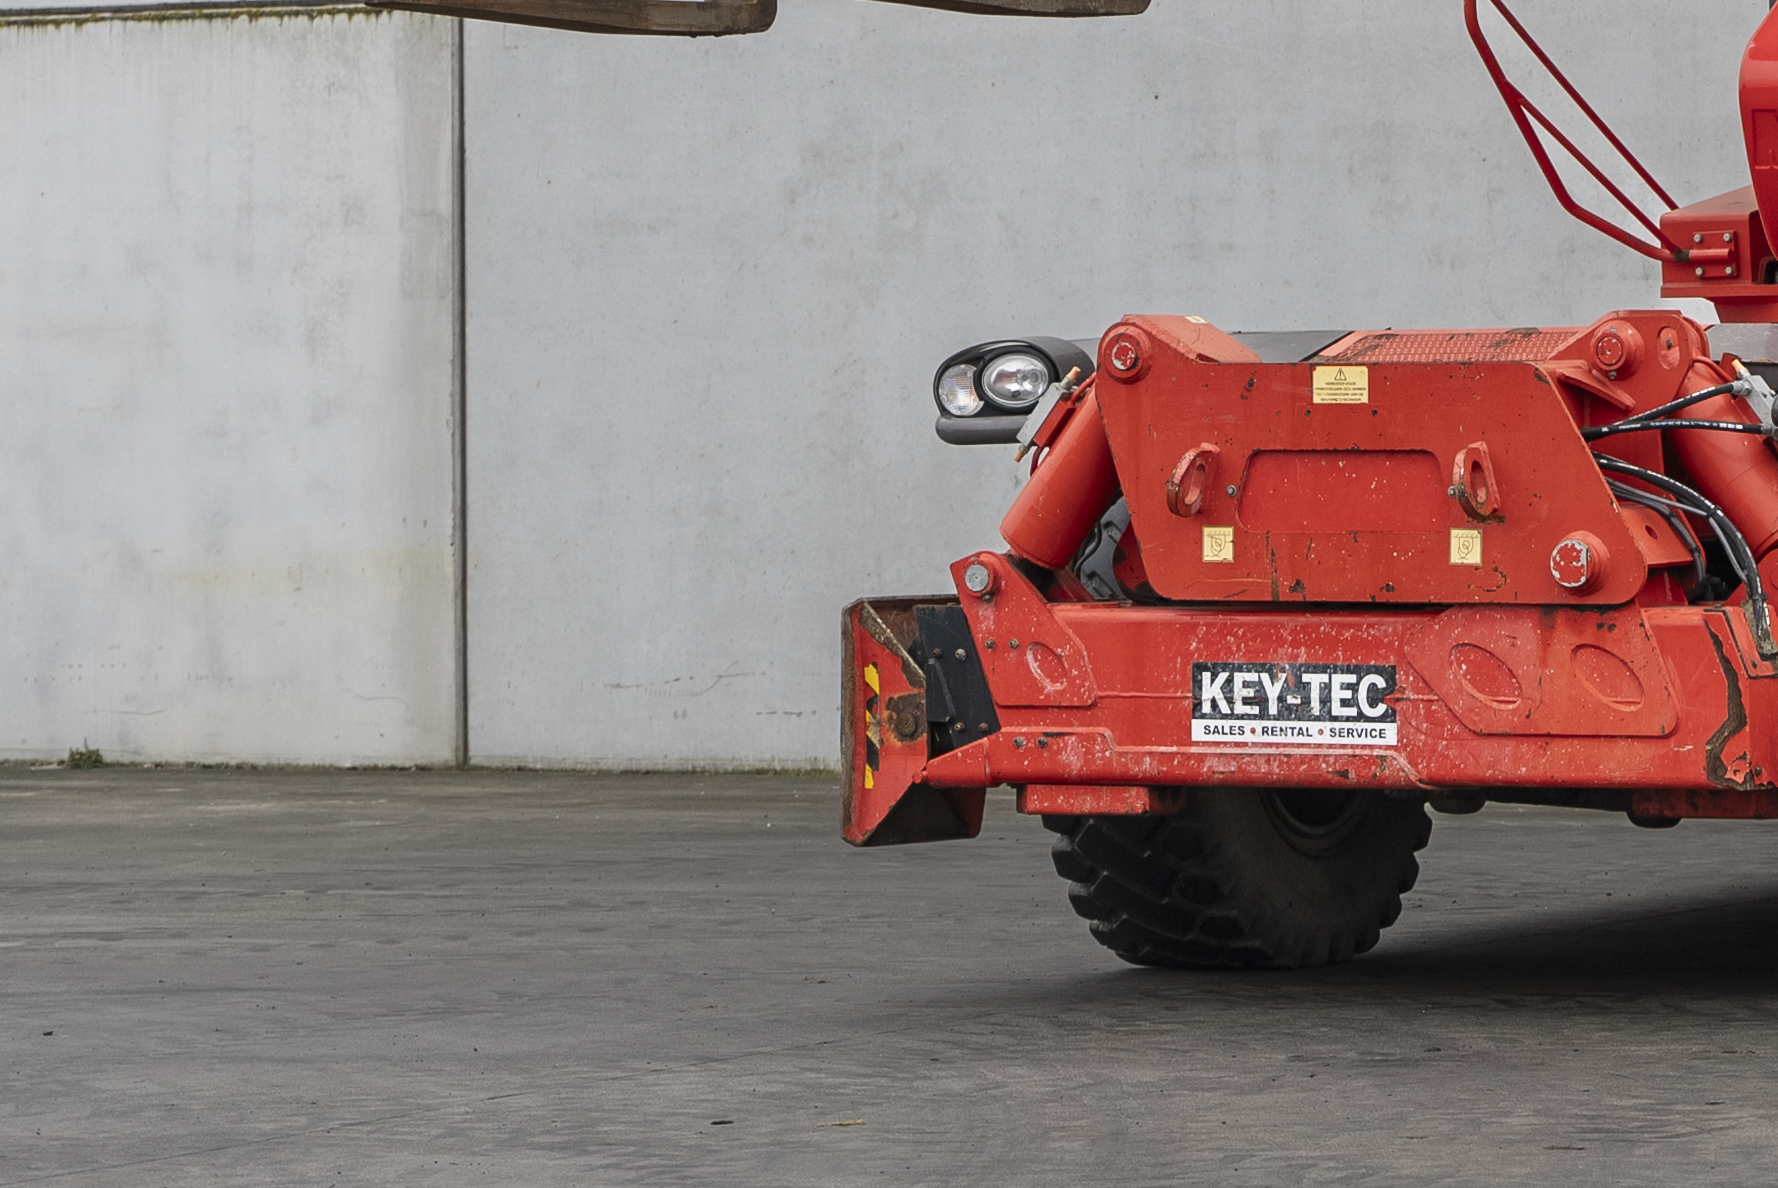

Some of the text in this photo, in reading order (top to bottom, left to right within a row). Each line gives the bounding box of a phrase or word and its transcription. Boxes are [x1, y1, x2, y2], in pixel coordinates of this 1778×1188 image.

[1201, 671, 1388, 718] KEY-TEC
[1203, 724, 1387, 739] SALES RENTAL SERVICE
